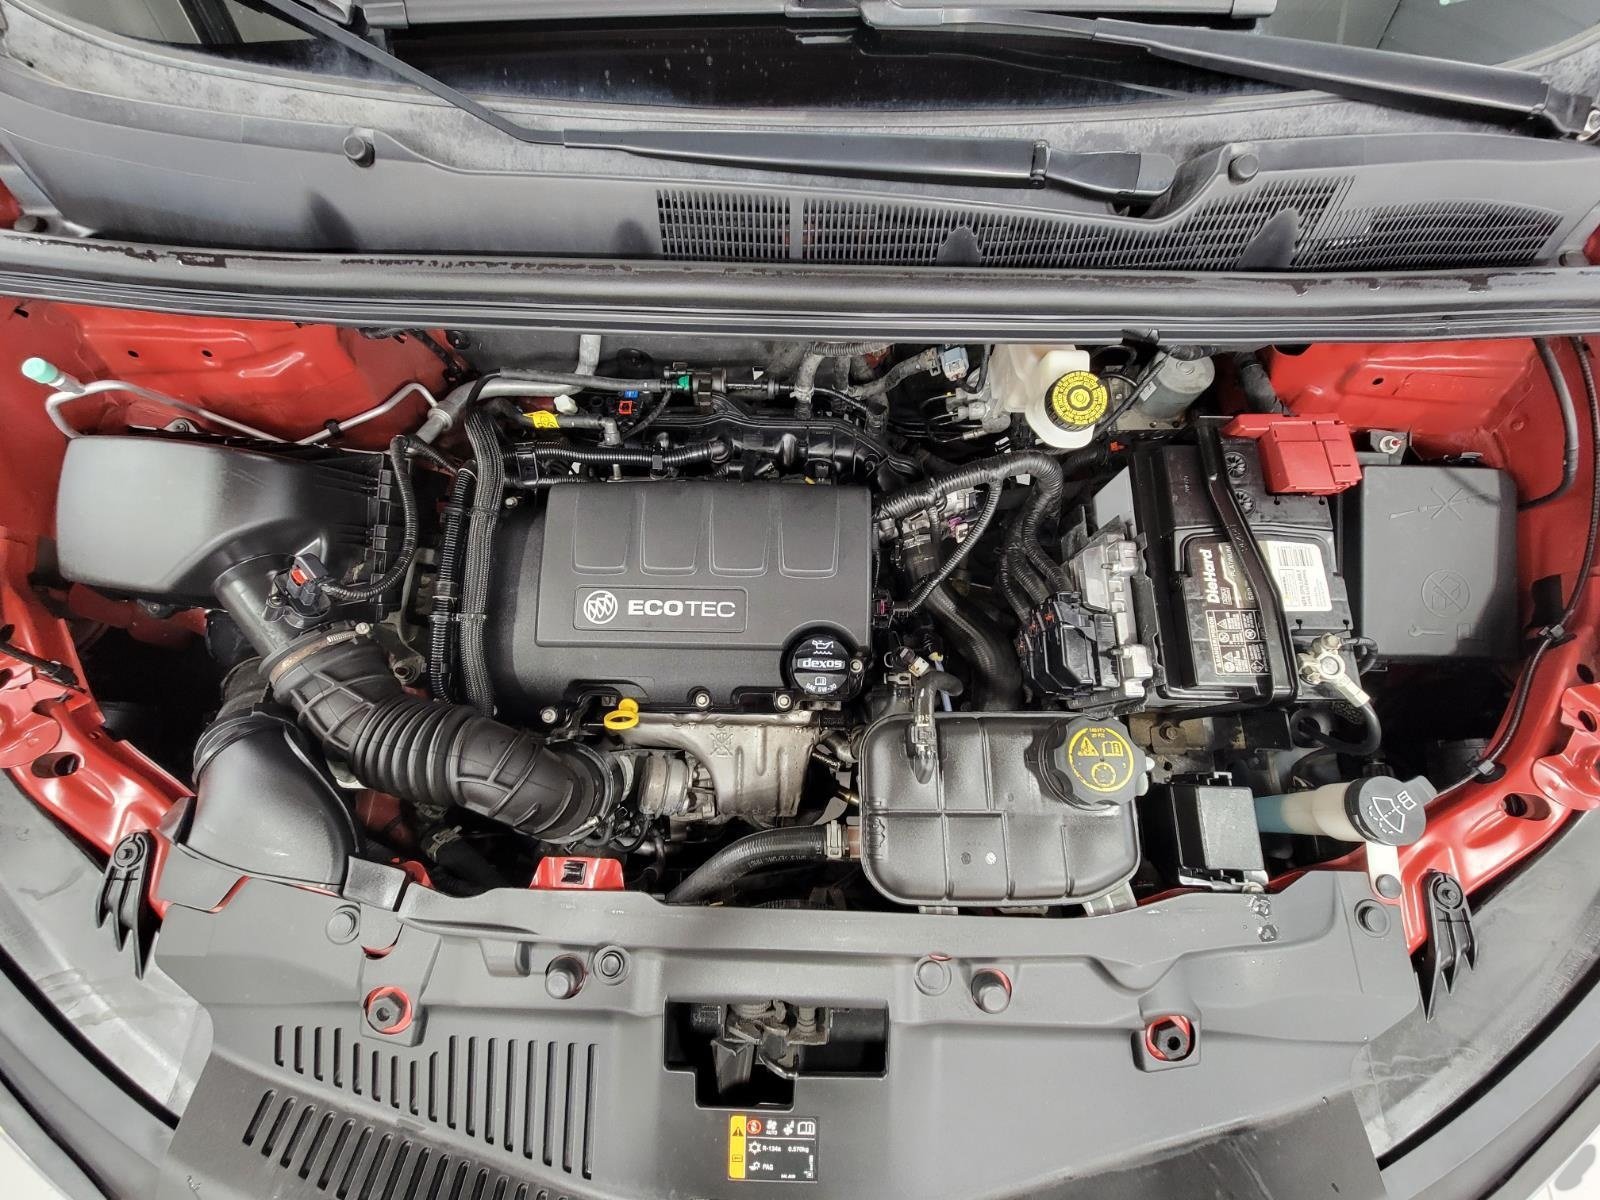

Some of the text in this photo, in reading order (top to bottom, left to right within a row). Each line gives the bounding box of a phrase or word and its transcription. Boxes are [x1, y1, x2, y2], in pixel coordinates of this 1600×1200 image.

[1225, 545, 1237, 577] PLATINUM
[1200, 548, 1220, 604] DieHard
[628, 600, 736, 617] ECOTEC
[803, 658, 842, 669] dexos
[805, 683, 837, 693] SAE 5W-30
[762, 1145, 782, 1153] R-134a
[762, 1163, 774, 1171] PAG
